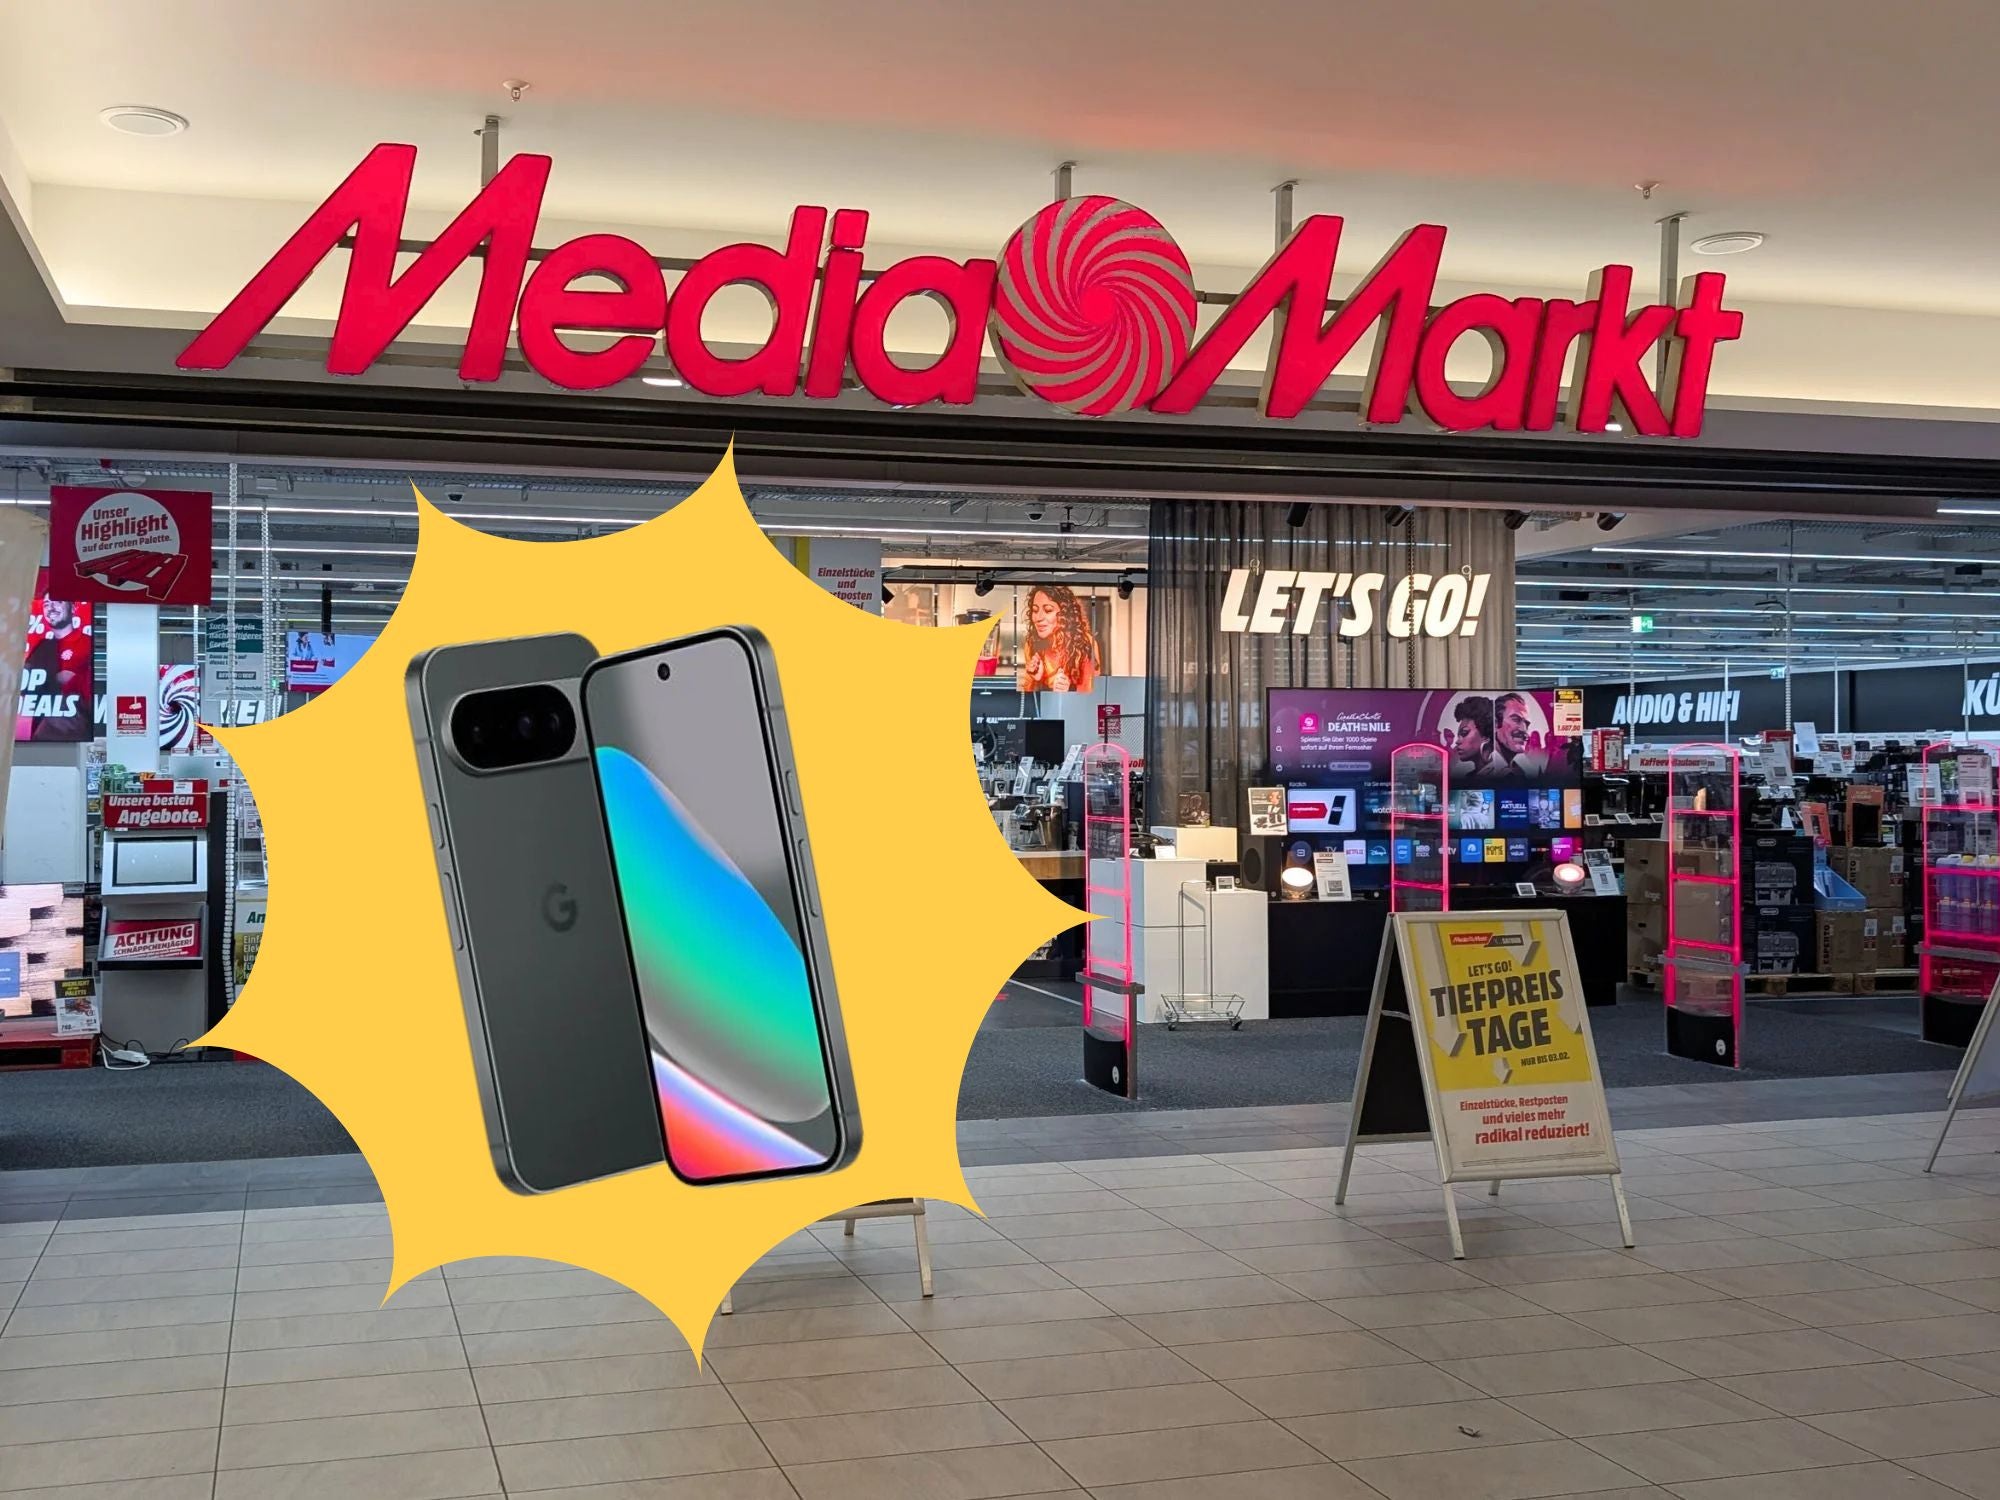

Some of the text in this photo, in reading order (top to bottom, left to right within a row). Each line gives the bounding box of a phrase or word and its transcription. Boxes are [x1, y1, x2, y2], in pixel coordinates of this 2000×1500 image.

[175, 143, 1743, 438] Media Markt
[93, 507, 129, 520] Unser
[81, 514, 168, 541] Highlight
[83, 544, 97, 552] auf
[98, 541, 113, 550] der
[114, 539, 138, 549] roten
[818, 567, 875, 577] Einzelstücke
[837, 579, 856, 588] und
[829, 591, 872, 600] tposten
[1220, 568, 1491, 638] LET'S GO!
[18, 694, 80, 717] EALS
[1612, 693, 1676, 725] AUDIO
[1678, 692, 1693, 723] &
[1695, 690, 1740, 723] HIFI
[1328, 722, 1360, 732] DEATH
[1369, 722, 1391, 732] NILE
[109, 794, 194, 806] Unsere besten
[117, 808, 202, 826] Angebote.
[114, 925, 193, 948] ACHTUNG
[113, 939, 192, 956] SCHNÄPPCHENJÄGER!
[1468, 960, 1513, 978] LET'S GO!
[1430, 969, 1564, 1018] TIEFPREIS
[1466, 1008, 1552, 1056] TAGE
[1548, 1052, 1570, 1061] 03.02.
[1460, 1095, 1568, 1111] Einzelstücke, Restposten
[1482, 1108, 1566, 1125] und vieles mehr
[1475, 1122, 1590, 1144] radikal reduziert!
